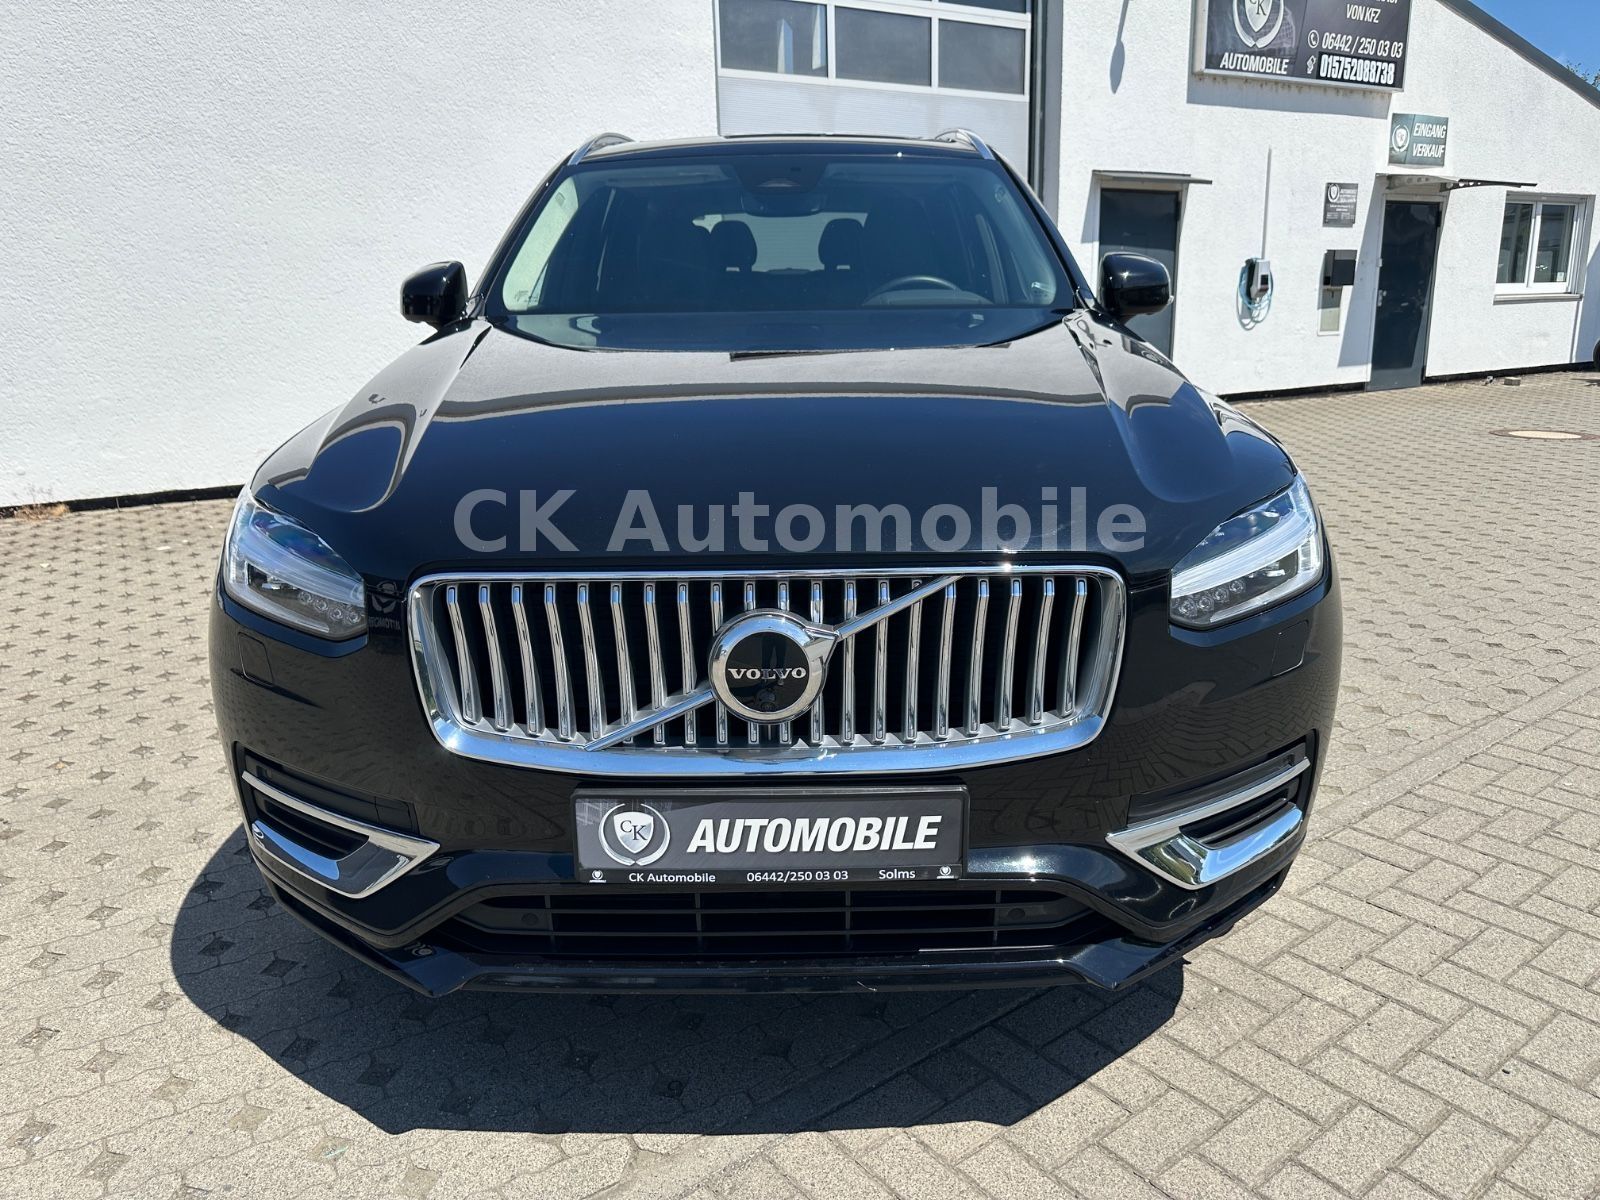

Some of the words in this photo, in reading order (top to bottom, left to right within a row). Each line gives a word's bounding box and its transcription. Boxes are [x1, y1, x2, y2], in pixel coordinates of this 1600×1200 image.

[1346, 4, 1365, 21] VON
[1365, 7, 1381, 23] KFZ
[1322, 32, 1352, 52] 06442
[1358, 37, 1376, 55] 250
[1377, 40, 1389, 57] 03
[1391, 41, 1403, 58] 03
[1220, 52, 1289, 74] AUTOMOBILE
[1319, 54, 1395, 84] 015752088738
[1413, 122, 1447, 139] EINGANG
[1412, 142, 1445, 158] VERKAUF
[728, 667, 807, 679] VOLVO
[620, 820, 648, 841] CK
[686, 815, 943, 854] AUTOMOBILE
[628, 872, 644, 883] CK
[647, 872, 716, 883] Automobile
[746, 871, 813, 883] 06442/250
[815, 871, 830, 881] 03
[833, 870, 849, 880] 03
[879, 868, 916, 880] Solms
